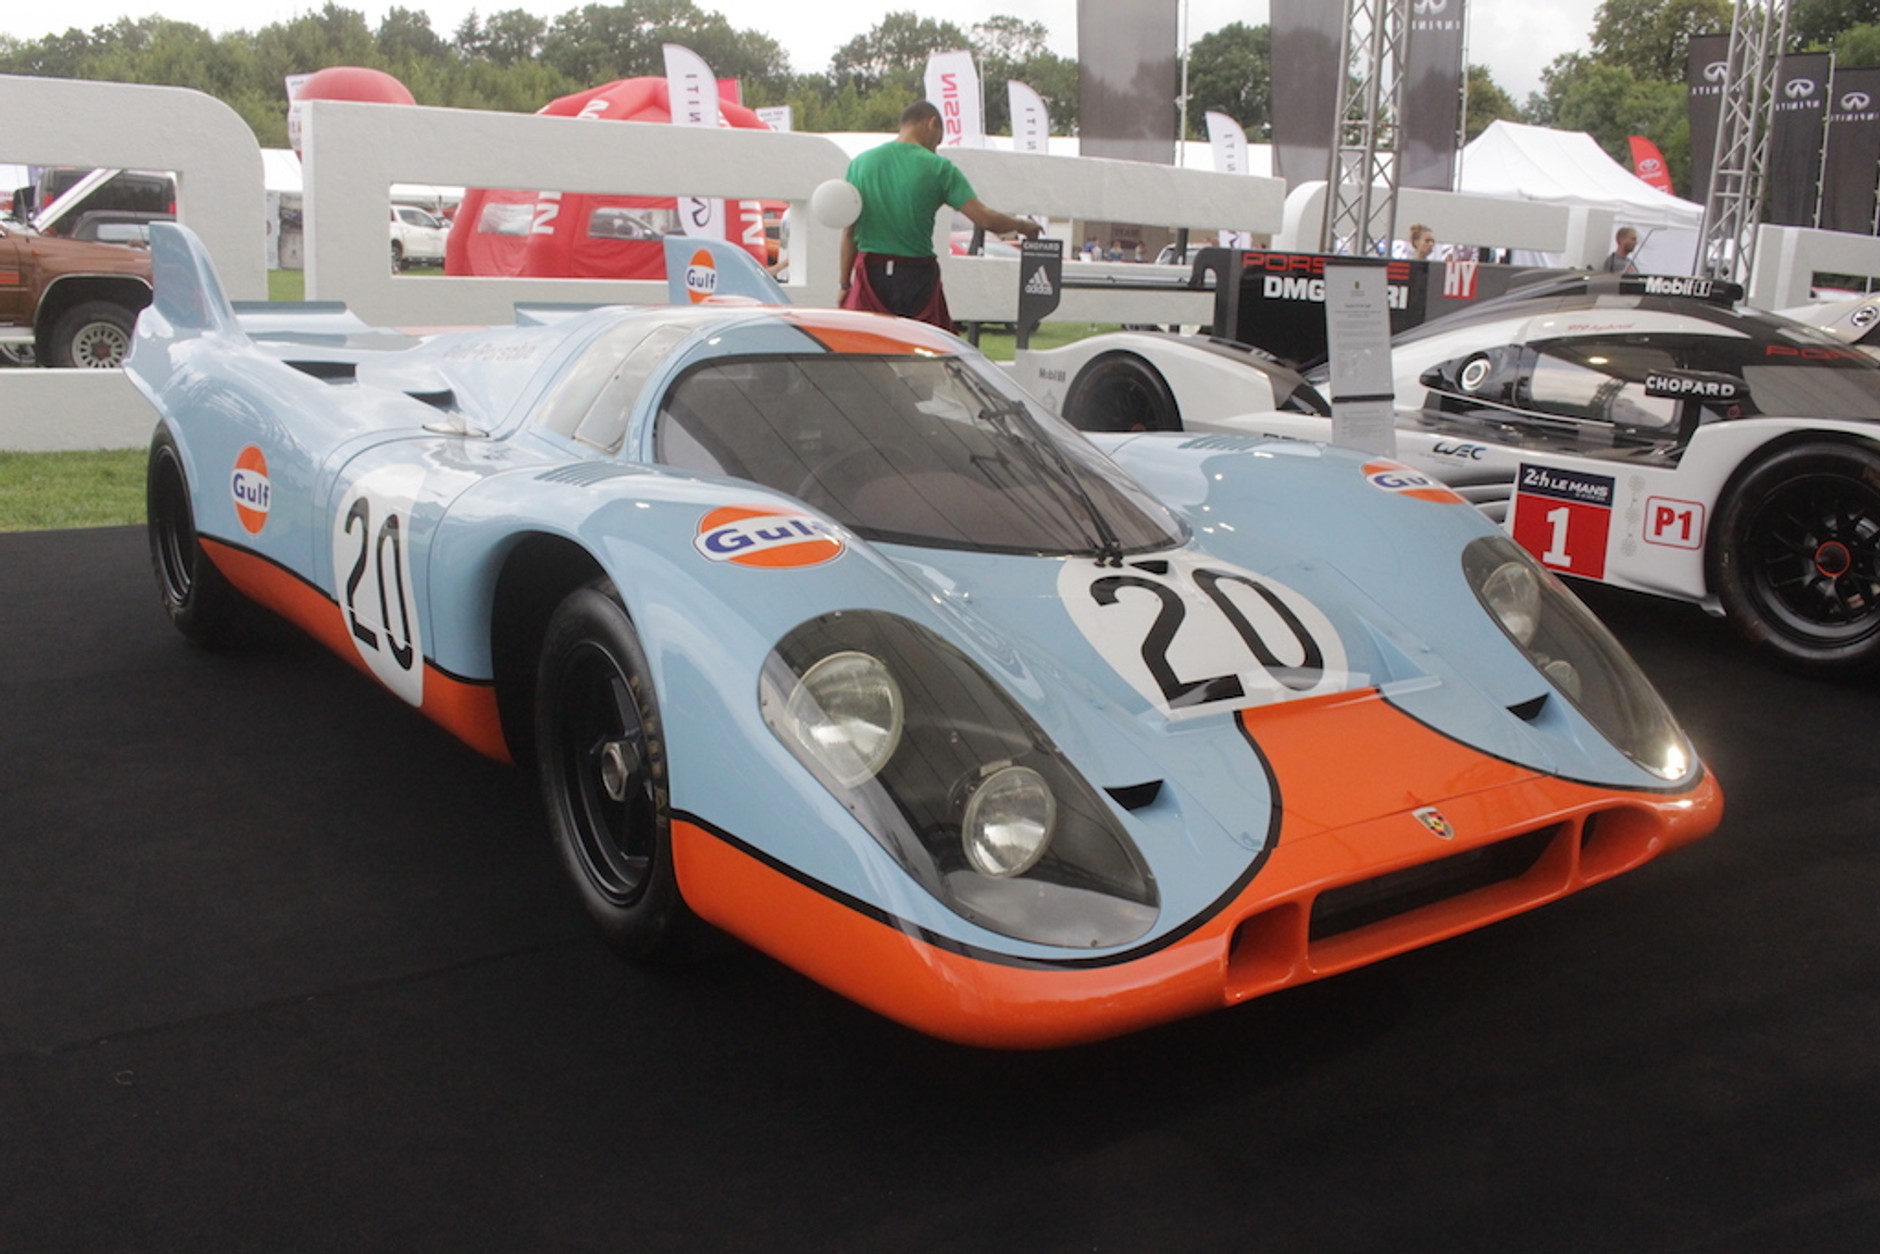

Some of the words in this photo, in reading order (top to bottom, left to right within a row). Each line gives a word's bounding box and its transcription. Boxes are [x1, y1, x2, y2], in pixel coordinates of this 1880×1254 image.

[687, 269, 715, 289] Gulf
[1025, 283, 1053, 295] adidas
[1263, 276, 1325, 302] DMG
[1445, 261, 1478, 297] HY
[1645, 277, 1694, 296] Mobil
[1645, 376, 1735, 396] CHOPARD
[1432, 441, 1487, 460] WEC
[233, 472, 270, 507] Gulf
[1550, 479, 1569, 490] LE
[1568, 481, 1608, 497] MANS
[1654, 506, 1692, 541] P1
[1542, 507, 1572, 568] 1
[345, 496, 413, 671] 20
[1089, 568, 1324, 710] 20
